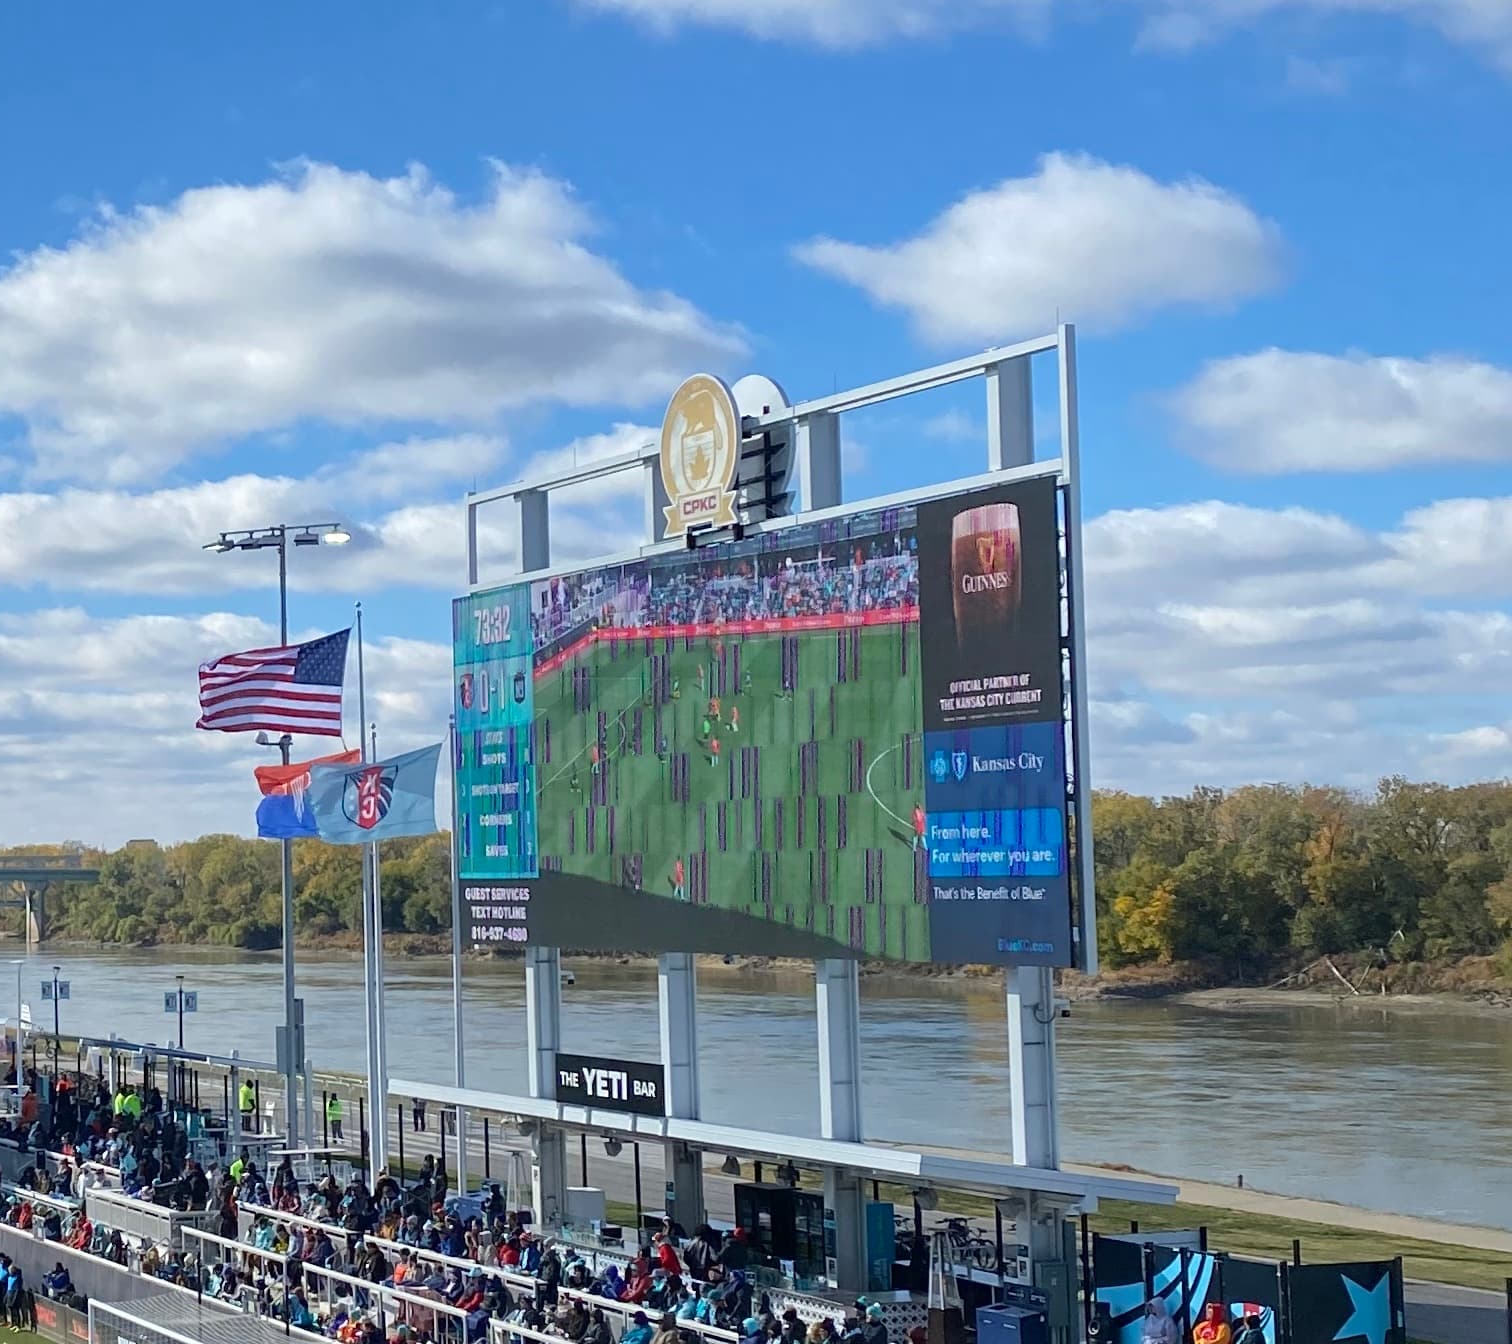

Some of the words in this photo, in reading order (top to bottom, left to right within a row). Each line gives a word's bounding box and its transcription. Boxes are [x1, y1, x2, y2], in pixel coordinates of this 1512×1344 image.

[682, 495, 717, 516] CPKC
[473, 605, 511, 647] 73:32
[949, 679, 982, 694] OFFICIAL
[983, 675, 1019, 690] PARTNER
[1019, 673, 1030, 686] OF
[939, 698, 955, 711] THE
[955, 695, 986, 709] KANSAS
[986, 692, 1005, 707] CITY
[1005, 689, 1042, 705] CURRENT
[482, 752, 507, 765] SHOTS
[972, 756, 1016, 773] Kansas
[1018, 752, 1044, 773] City
[931, 825, 961, 841] From
[961, 824, 991, 840] here.
[932, 849, 950, 864] For
[952, 848, 1005, 863] wherever
[1008, 849, 1029, 867] you
[1031, 849, 1056, 862] are.
[464, 887, 490, 901] GUEST
[491, 887, 530, 901] SERVICES
[933, 886, 959, 900] That's
[959, 886, 976, 900] the
[976, 886, 1009, 900] Benefit
[1010, 886, 1021, 900] of
[471, 905, 491, 919] TEXT
[491, 906, 527, 920] HOTLINE
[997, 937, 1054, 953] BlueKC.com
[559, 1070, 580, 1088] THE
[582, 1067, 628, 1101] YETI
[633, 1080, 656, 1098] BAR
